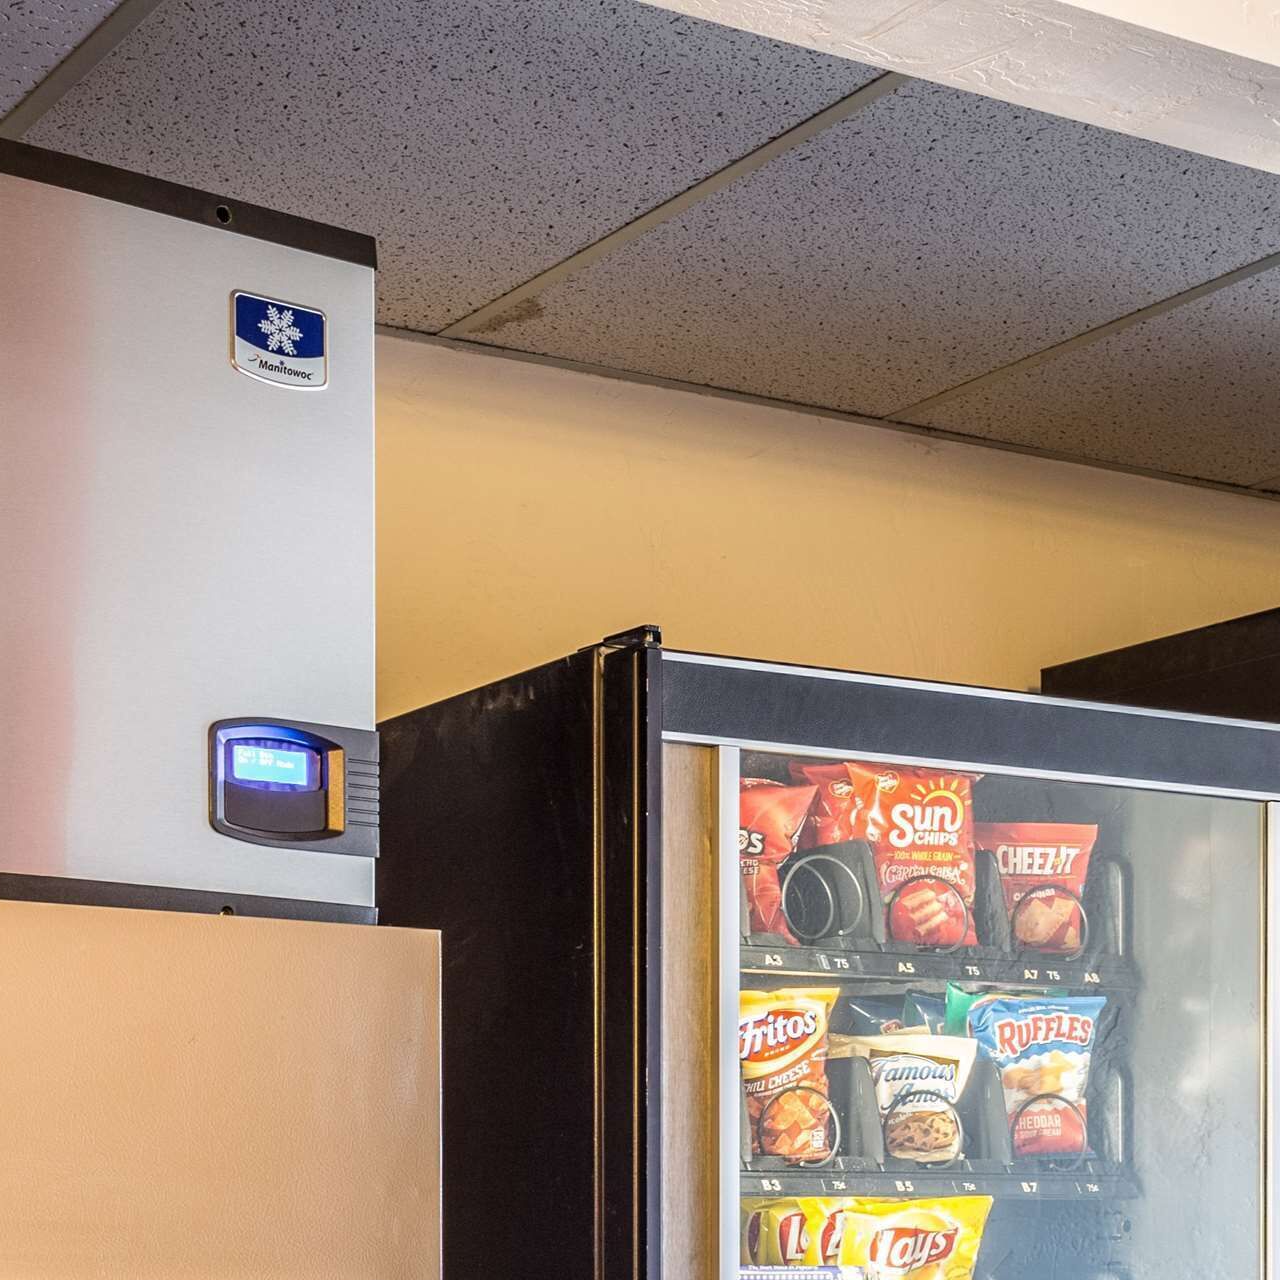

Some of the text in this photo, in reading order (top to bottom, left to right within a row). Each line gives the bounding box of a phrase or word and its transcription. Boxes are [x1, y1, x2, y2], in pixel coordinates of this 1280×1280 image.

[258, 359, 312, 381] Manitowoc
[889, 803, 963, 848] Sun
[914, 831, 959, 846] CHIPS
[764, 955, 783, 967] A3
[834, 959, 849, 969] 75
[898, 963, 915, 973] A5
[965, 966, 980, 976] 75
[1024, 970, 1038, 980] A7
[1047, 970, 1061, 981] 75
[739, 1011, 816, 1060] Fritos
[996, 1012, 1093, 1056] RUFFLES
[768, 1060, 811, 1089] CHEESE
[871, 1055, 956, 1082] Famous
